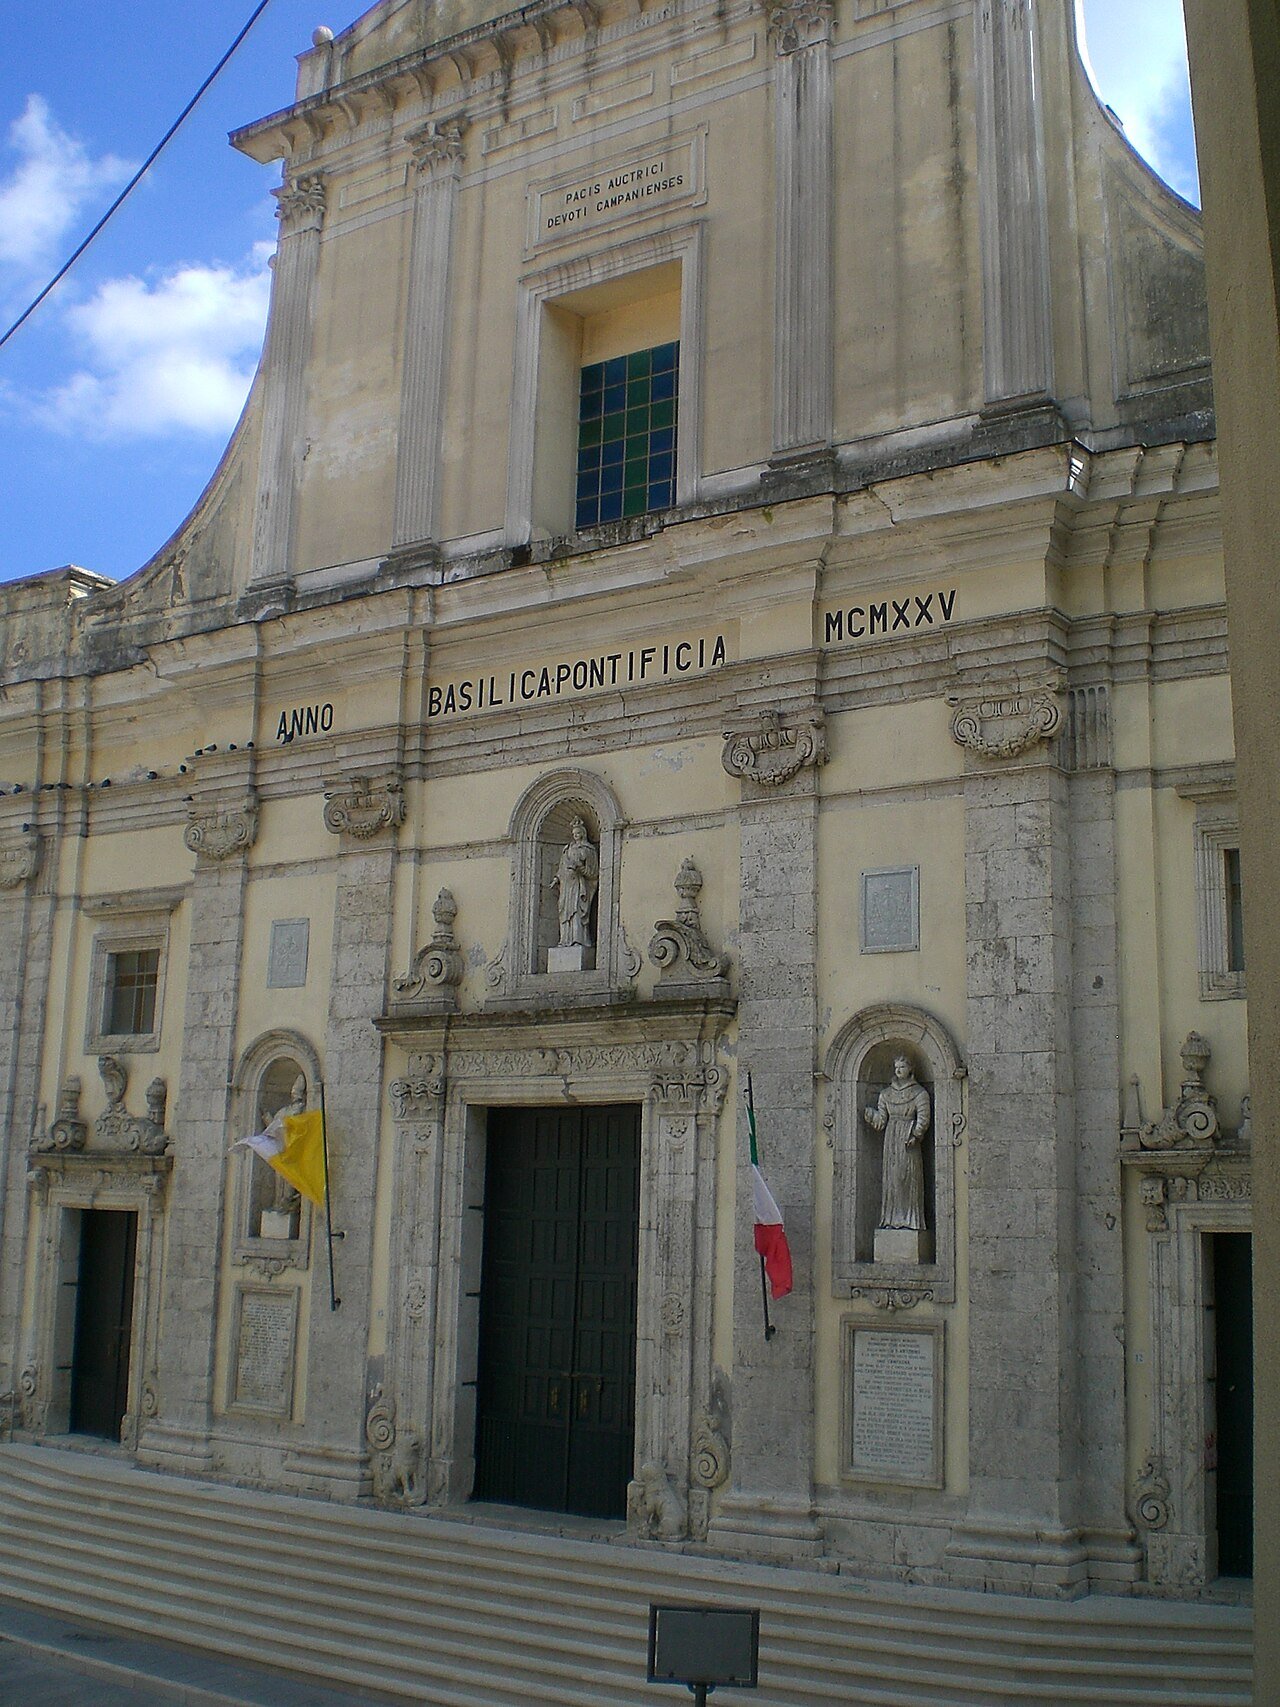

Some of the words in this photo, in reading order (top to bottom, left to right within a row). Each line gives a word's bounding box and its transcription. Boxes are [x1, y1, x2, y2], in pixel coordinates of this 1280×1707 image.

[547, 207, 587, 229] DEVOTI
[596, 175, 684, 212] CAMPANIENSES
[565, 183, 601, 204] PACIS
[608, 162, 665, 190] AUCTRICI
[276, 703, 334, 741] ANNO
[825, 589, 957, 643] MCMXXV
